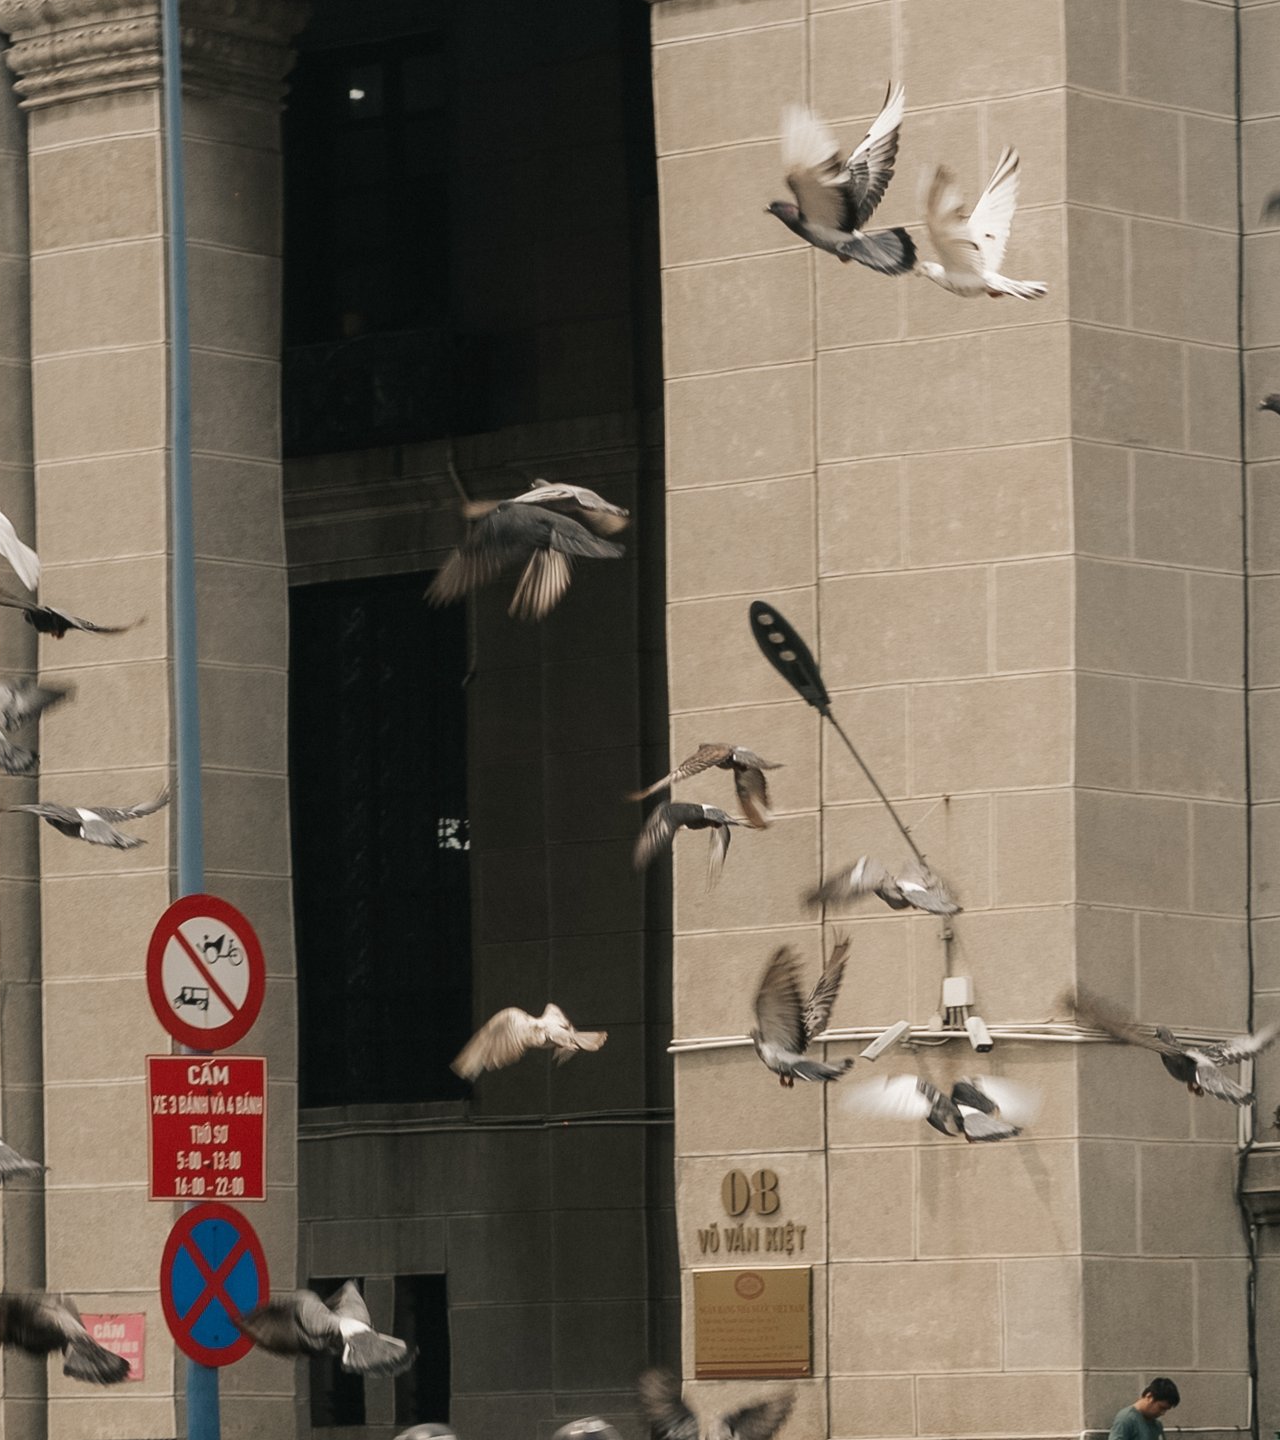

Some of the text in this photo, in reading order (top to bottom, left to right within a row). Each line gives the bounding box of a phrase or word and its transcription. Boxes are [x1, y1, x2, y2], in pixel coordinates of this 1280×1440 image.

[187, 1059, 230, 1085] CẤM
[153, 1095, 168, 1114] XE
[169, 1095, 177, 1114] 3
[178, 1090, 209, 1114] BÁNH
[226, 1095, 234, 1114] 4
[235, 1091, 263, 1114] BÁNH
[176, 1150, 202, 1170] 5:00
[212, 1150, 241, 1170] 13:00
[174, 1176, 205, 1196] 16:00
[215, 1176, 245, 1196] 22:00
[721, 1168, 781, 1216] 08
[765, 1220, 807, 1256] KIỆT
